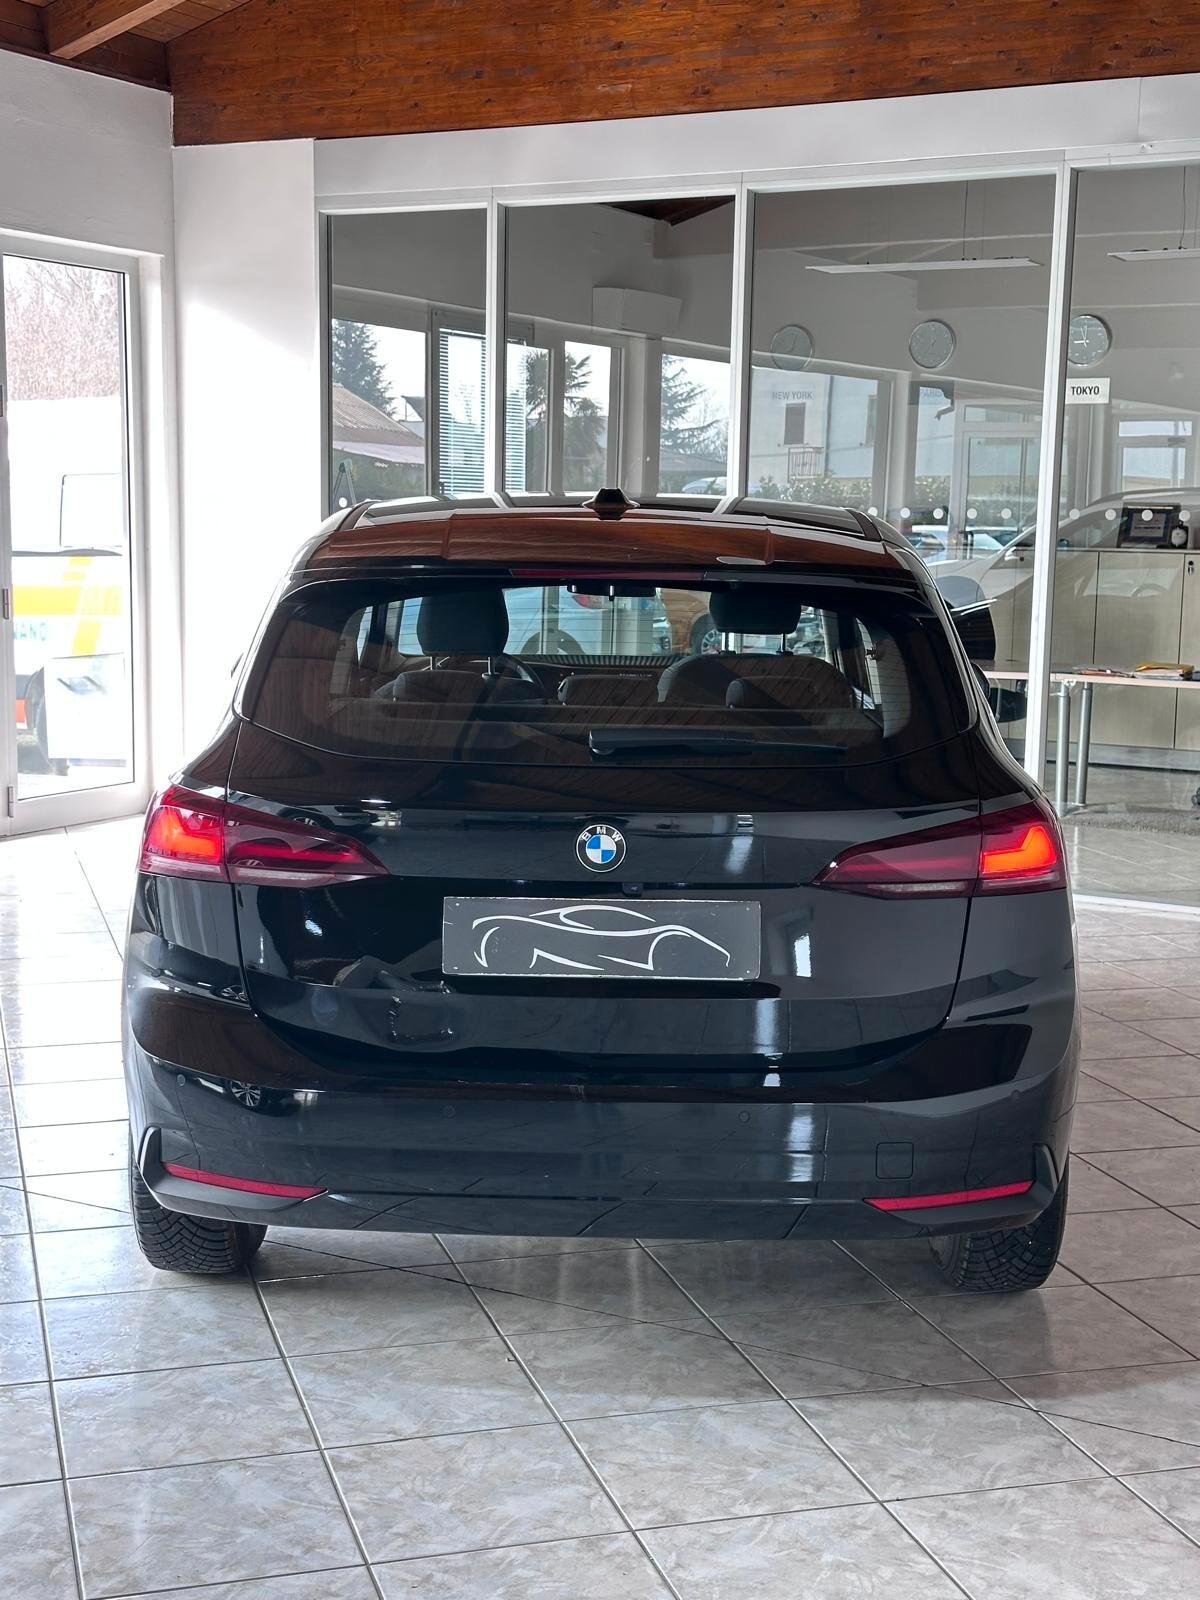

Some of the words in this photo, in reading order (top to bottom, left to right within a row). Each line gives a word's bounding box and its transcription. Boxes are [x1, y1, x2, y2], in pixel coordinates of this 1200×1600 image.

[772, 391, 790, 401] NEW
[791, 391, 814, 401] YORK
[1070, 385, 1100, 396] TOKYO
[581, 826, 622, 842] BMW
